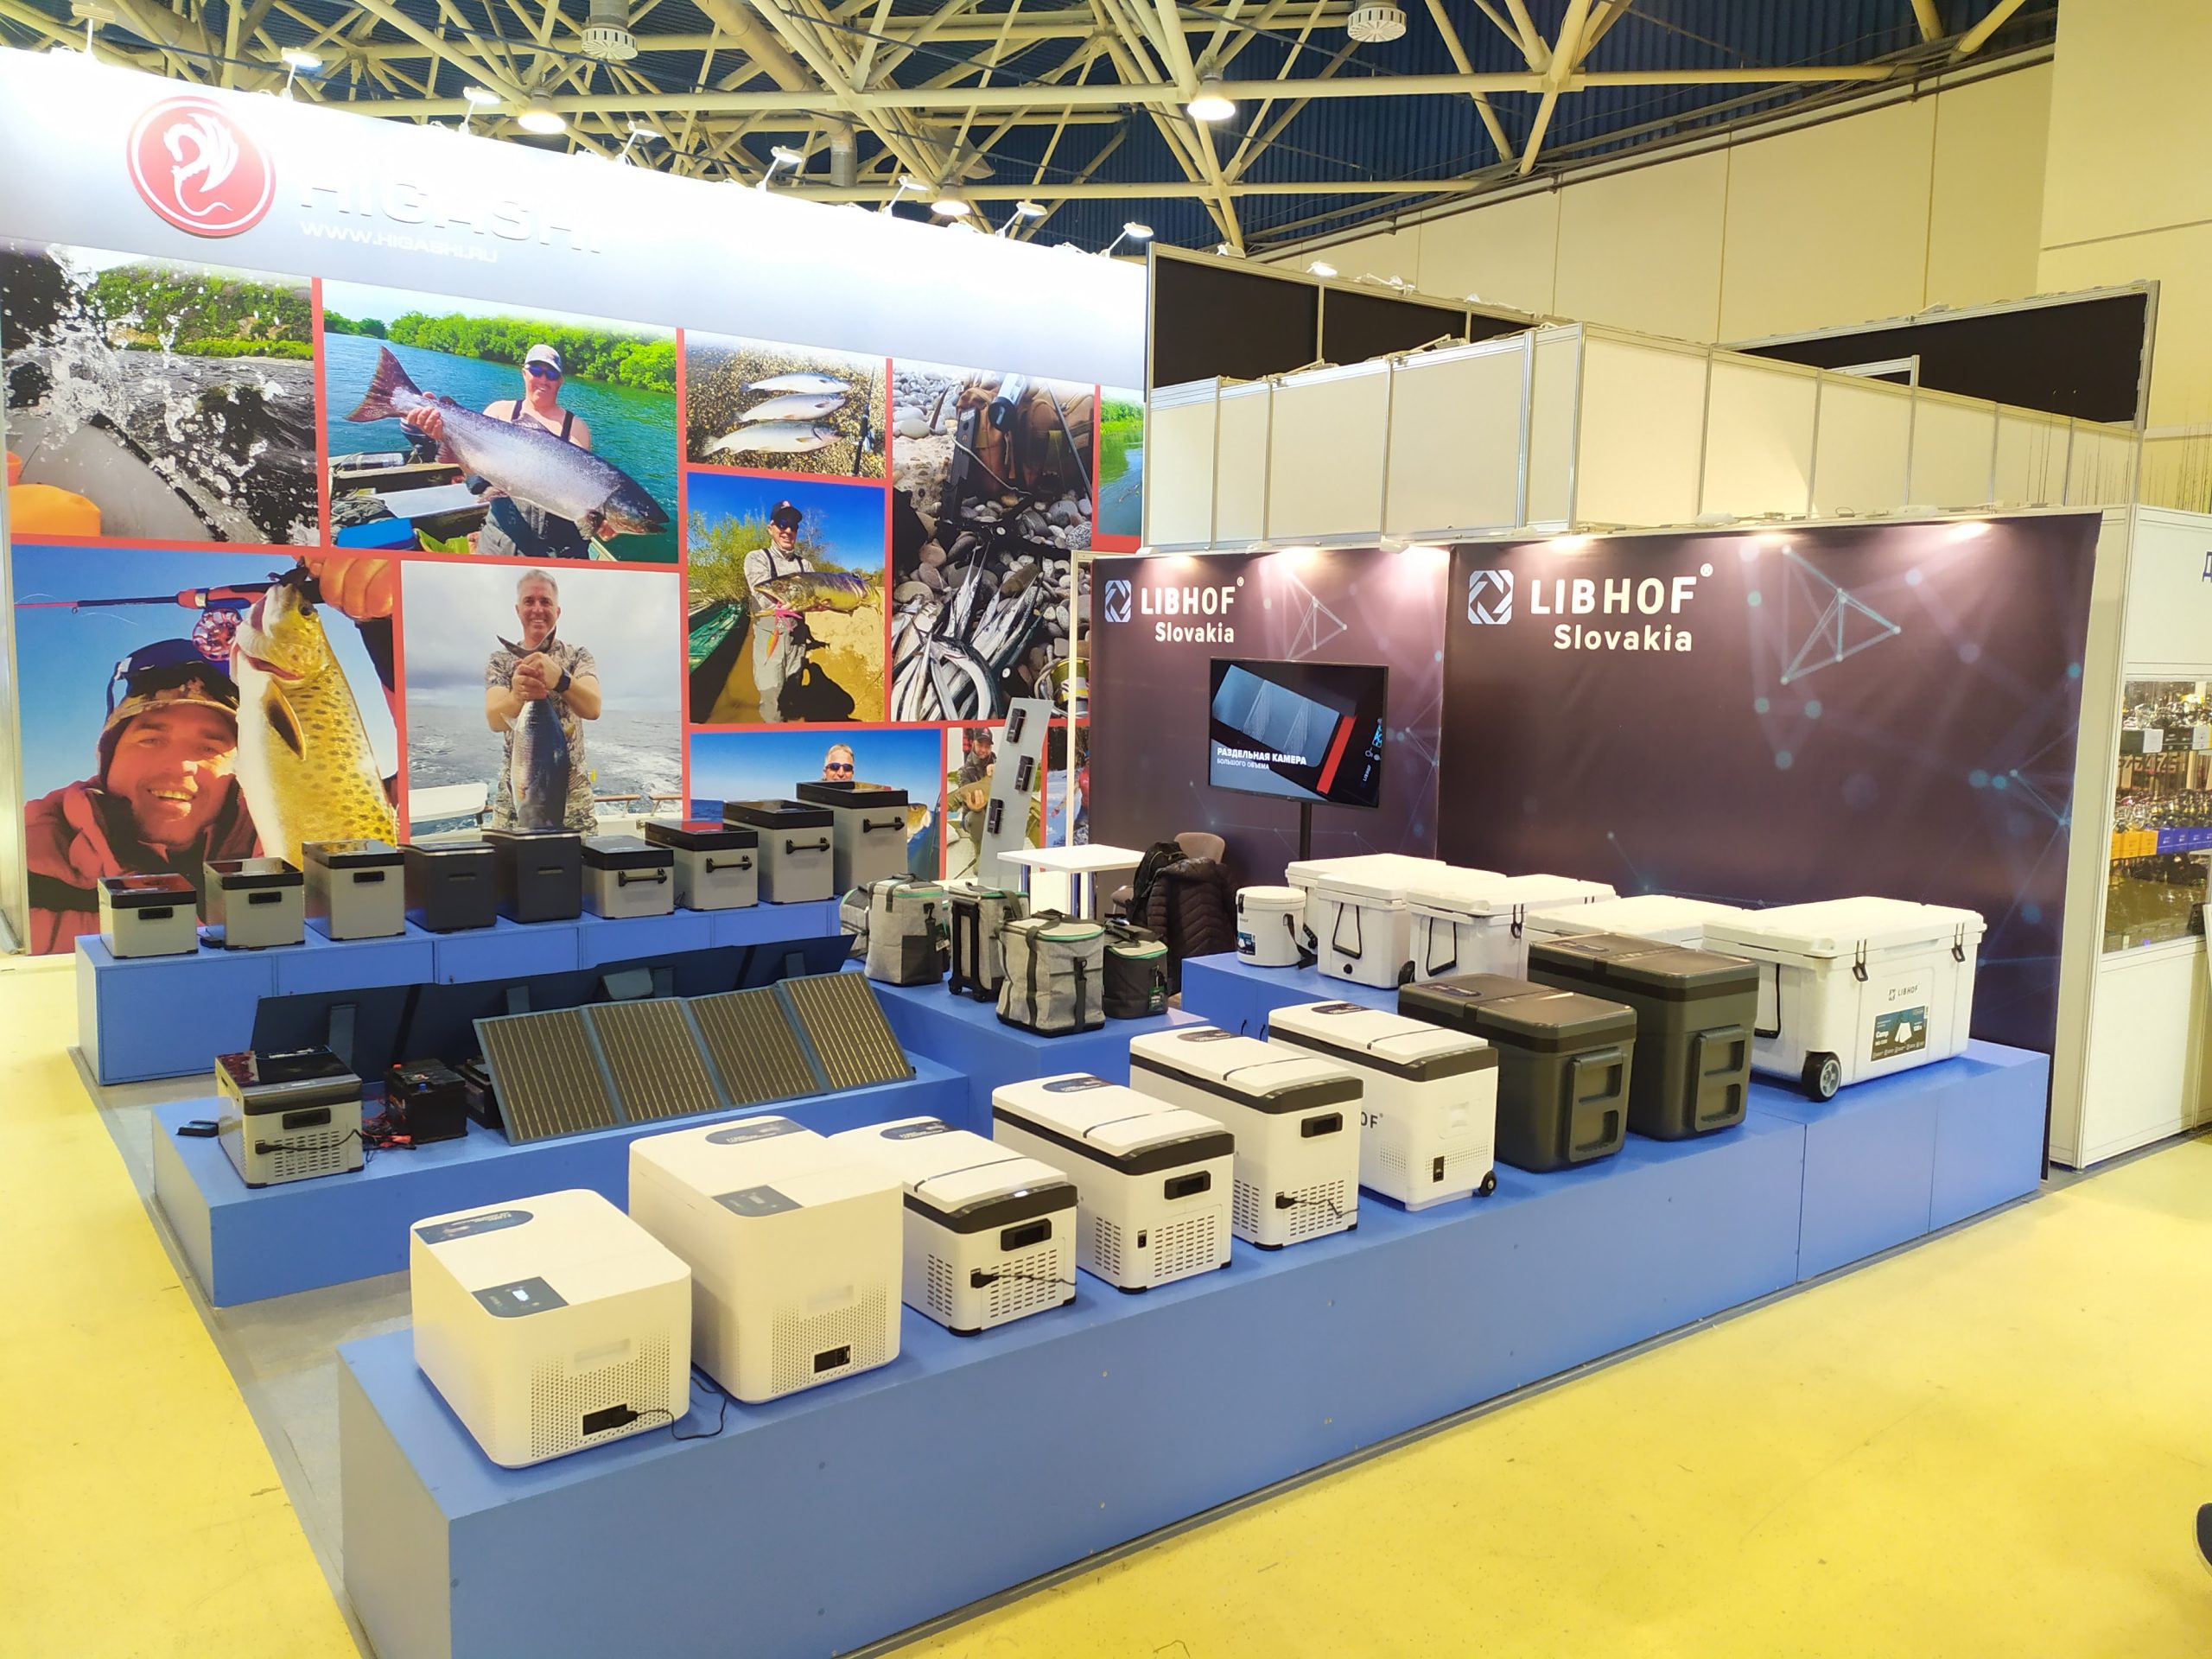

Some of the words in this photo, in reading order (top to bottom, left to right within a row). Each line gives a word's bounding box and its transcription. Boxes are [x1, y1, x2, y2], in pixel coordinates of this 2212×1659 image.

[300, 220, 498, 263] WWW.HIGASHI.RU
[1141, 587, 1236, 614] LIBHOF
[1530, 576, 1697, 614] LIBHOF
[1154, 621, 1234, 643] Slovakia
[1553, 624, 1692, 652] Slovakia
[1217, 747, 1271, 761] РАЗДЕЛЬНАЯ
[1272, 753, 1307, 766] КАМЕРА
[1217, 758, 1246, 767] БОЛЬШОГО
